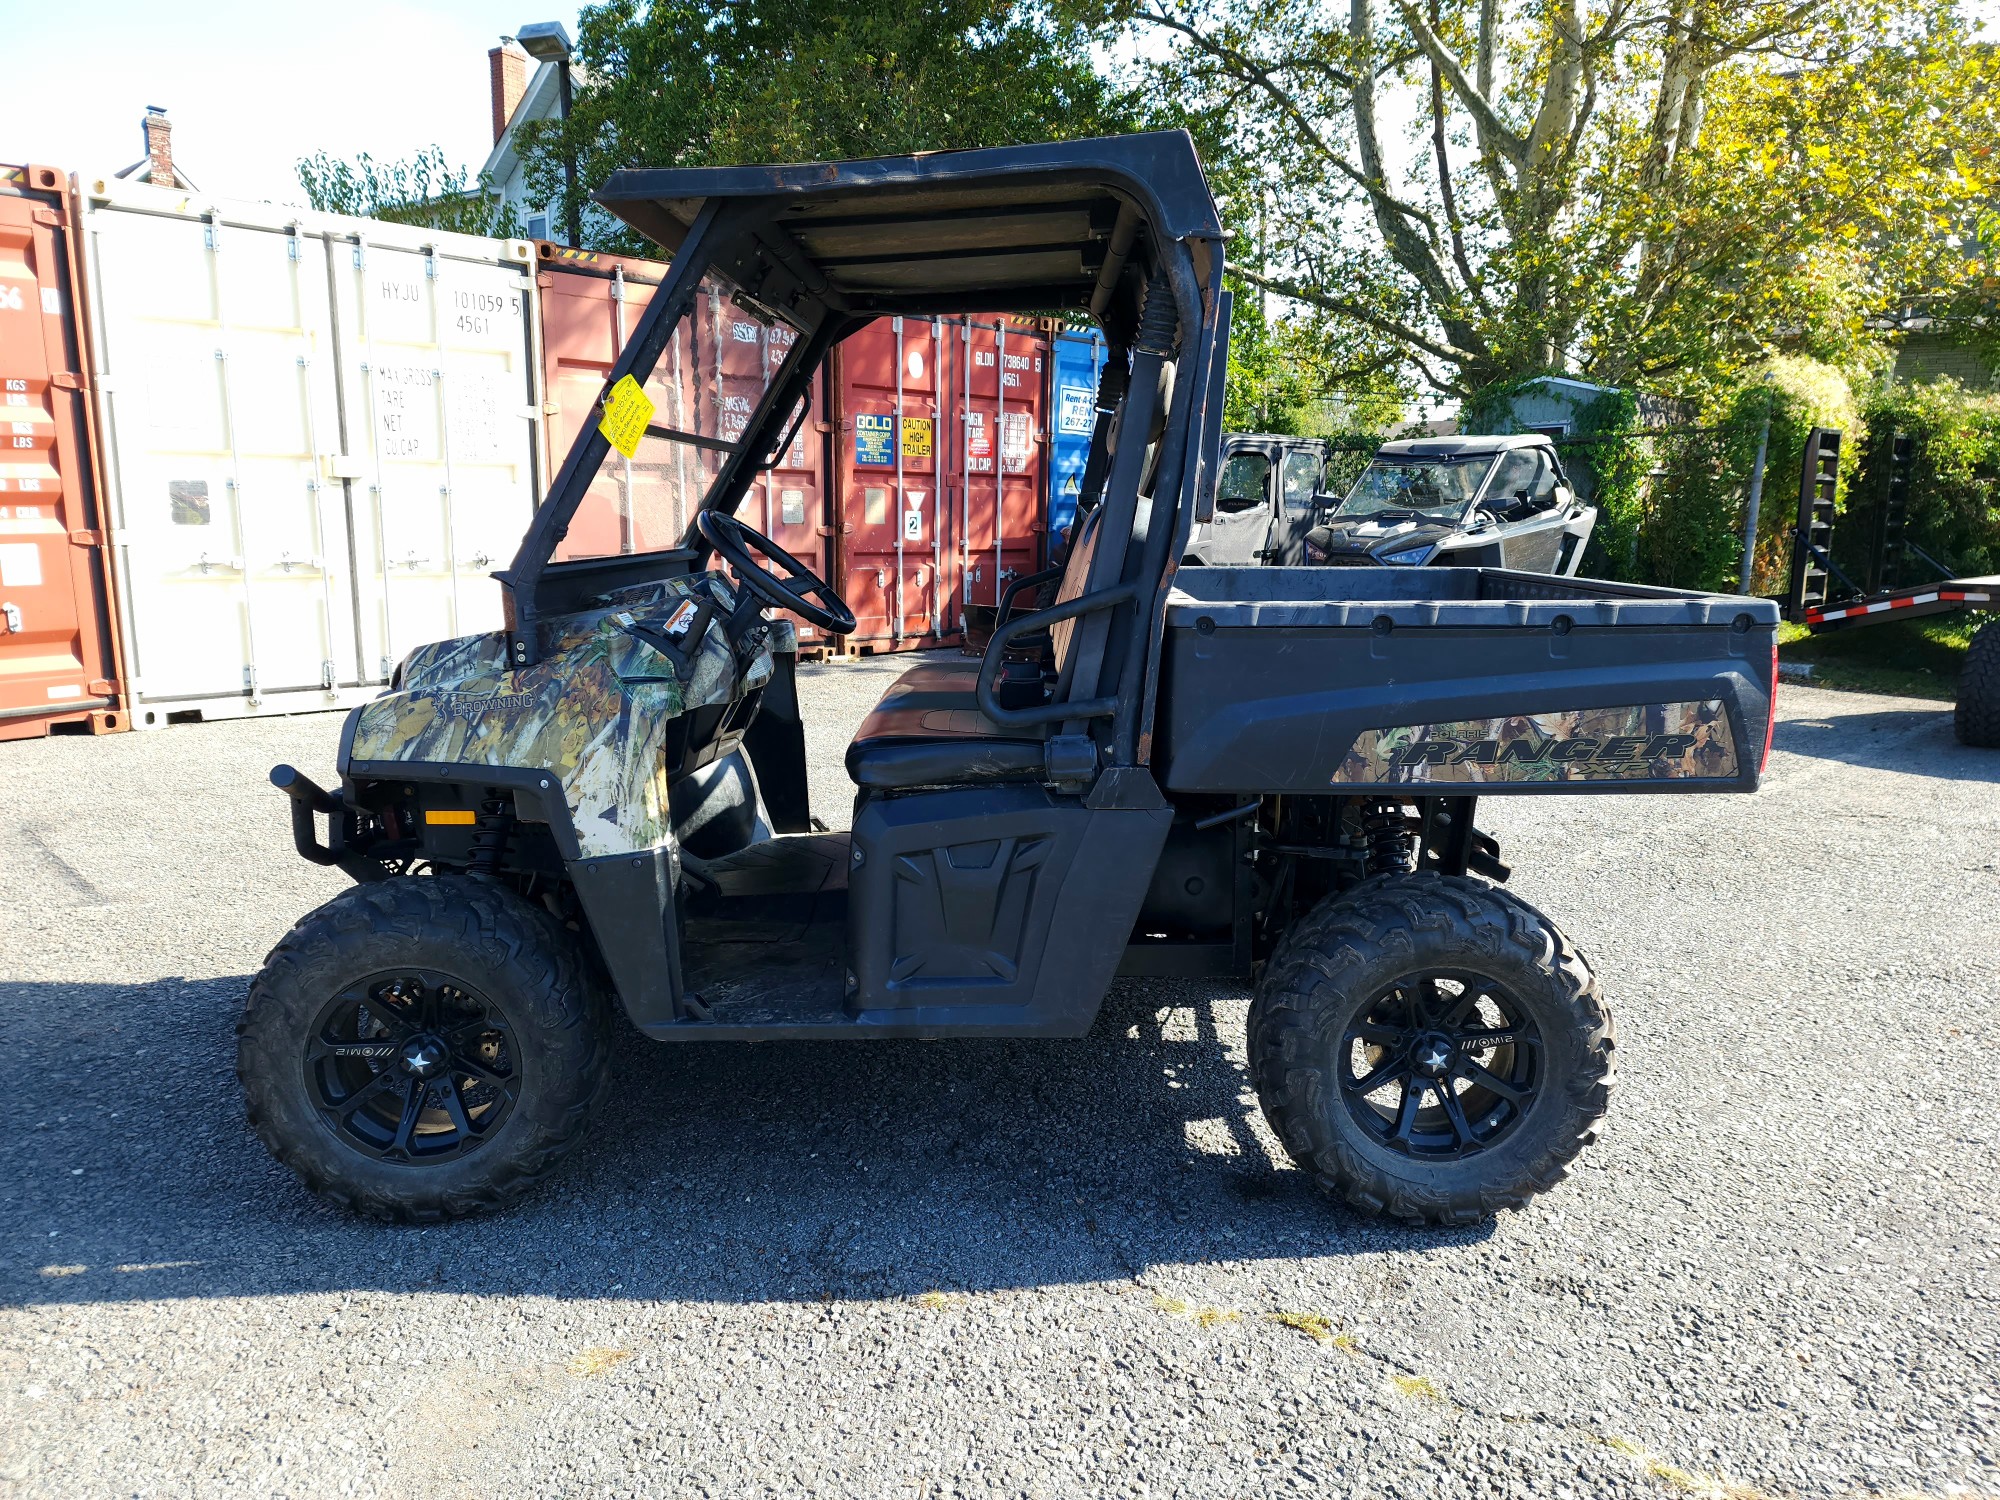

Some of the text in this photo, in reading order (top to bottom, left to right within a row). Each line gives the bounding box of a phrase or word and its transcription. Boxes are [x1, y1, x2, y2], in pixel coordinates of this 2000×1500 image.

[382, 281, 520, 315] HYJU 101059 5
[457, 315, 489, 335] 45G1
[975, 351, 994, 367] GLDU
[1004, 355, 1030, 370] 738640
[6, 379, 27, 391] KGS
[382, 390, 405, 409] TARE
[383, 414, 402, 431] NET
[856, 415, 892, 430] GOLD
[902, 418, 931, 431] CAUTION
[909, 432, 924, 443] HIGH
[969, 427, 984, 438] TARE
[13, 436, 33, 448] LBS
[902, 443, 931, 456] TRAILER
[453, 693, 535, 717] BROWNING
[1430, 730, 1489, 739] POLARIS
[1398, 734, 1698, 766] RANGER
[1575, 761, 1650, 775] XP
